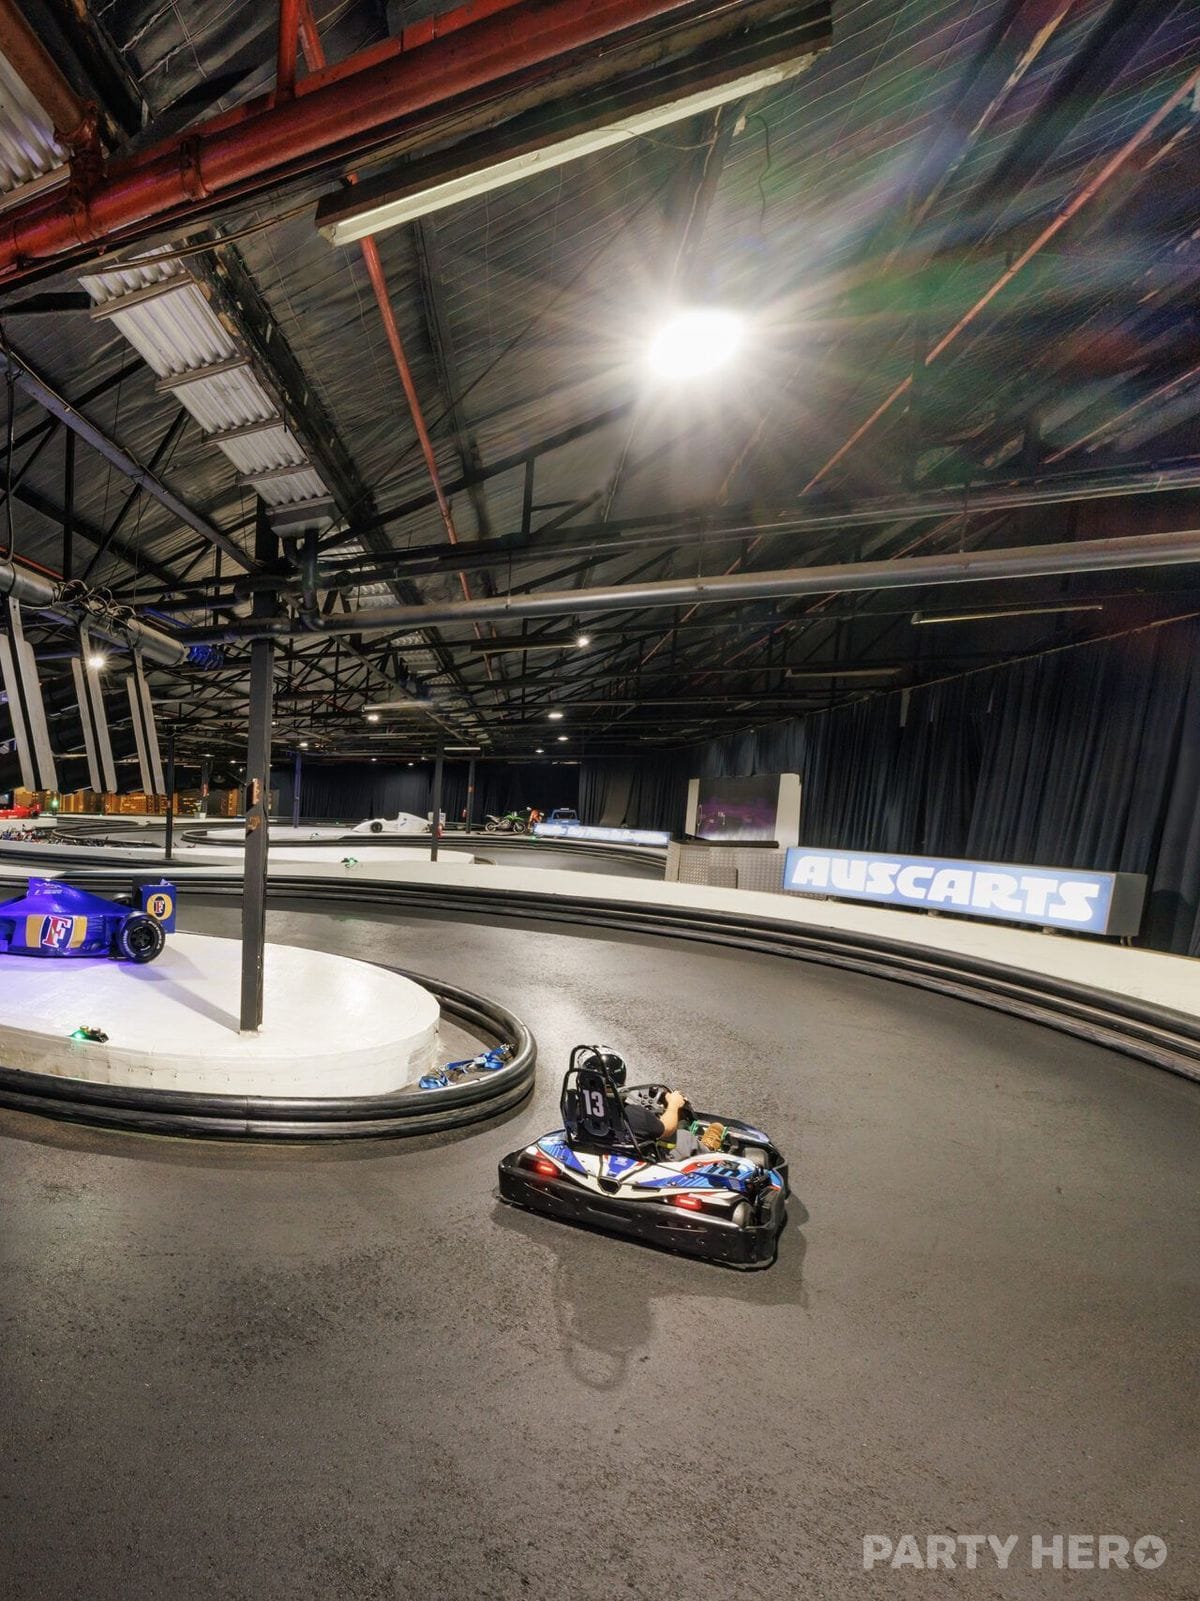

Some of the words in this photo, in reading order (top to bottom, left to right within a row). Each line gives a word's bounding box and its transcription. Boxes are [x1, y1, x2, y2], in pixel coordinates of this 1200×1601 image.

[791, 855, 1100, 922] AUSCARTS
[42, 916, 73, 948] F
[583, 1089, 605, 1118] 13
